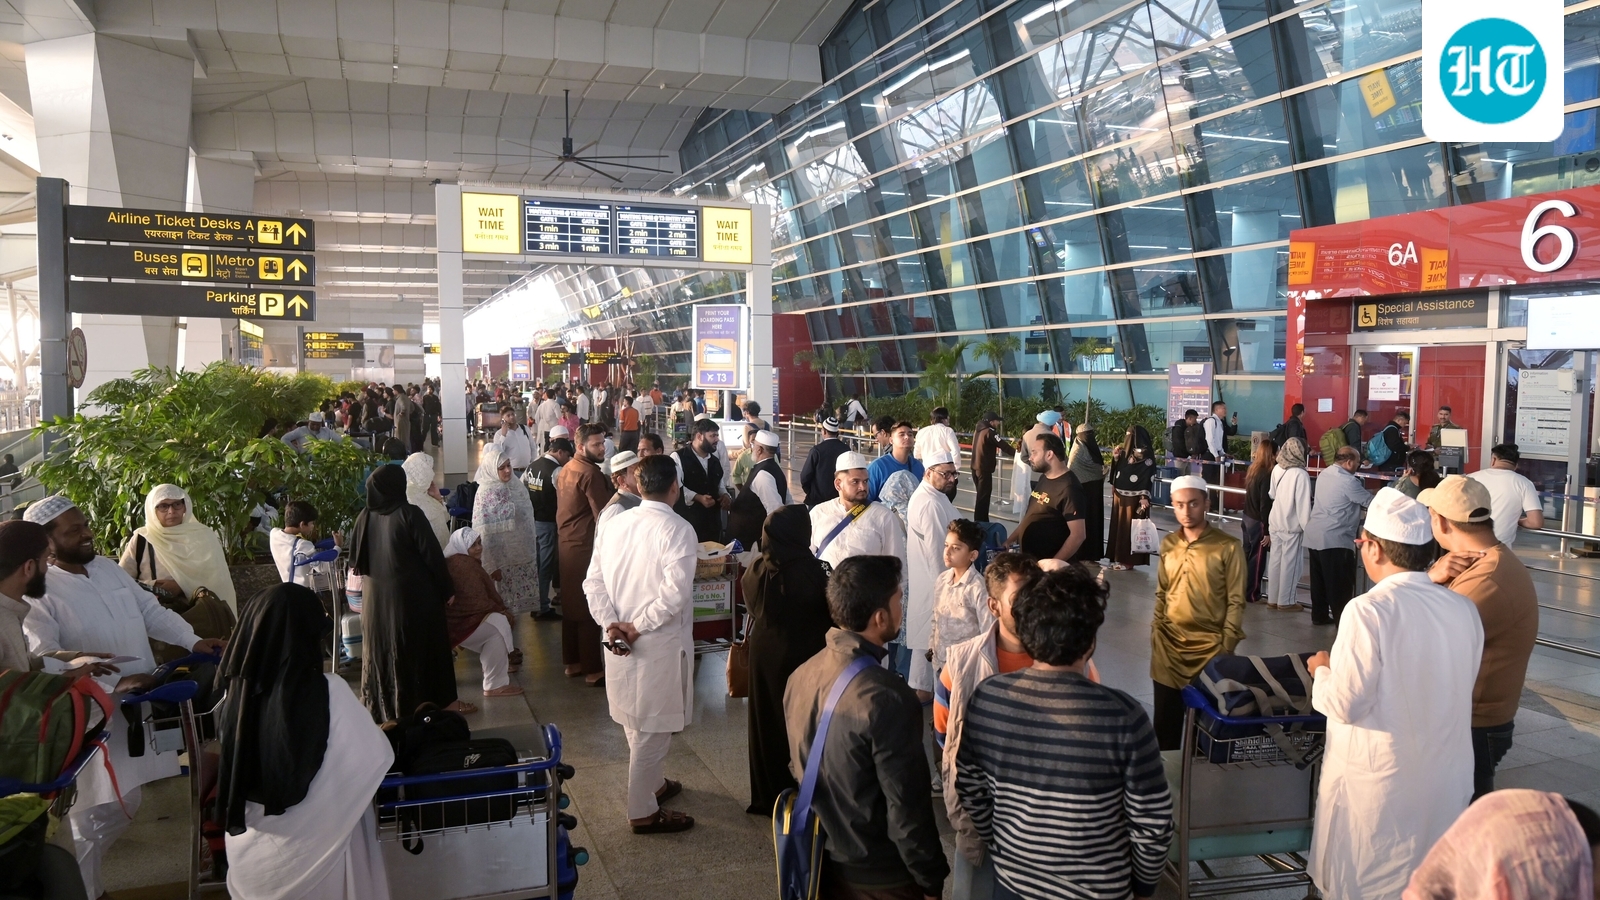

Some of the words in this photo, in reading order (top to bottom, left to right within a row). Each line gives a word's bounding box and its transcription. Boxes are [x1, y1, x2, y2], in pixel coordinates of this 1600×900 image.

[479, 207, 504, 217] WAIT
[108, 212, 150, 224] Airline
[155, 214, 196, 228] Ticket
[200, 216, 241, 230] Desks
[245, 220, 254, 230] A
[479, 220, 504, 230] TIME
[716, 220, 738, 230] WAIT
[144, 229, 183, 240] एयरलाइन
[187, 230, 210, 240] टिकट
[214, 231, 234, 241] डेस्क
[248, 235, 254, 244] ए
[716, 232, 738, 242] TIME
[1520, 200, 1577, 273] 6
[134, 250, 178, 264] Buses
[1388, 241, 1418, 266] 6A
[216, 254, 254, 267] Metro
[144, 267, 158, 275] बस
[162, 265, 178, 276] सेवा
[206, 290, 256, 305] Parking
[232, 305, 256, 315] पार्किंग
[266, 297, 278, 312] P
[1378, 303, 1414, 315] Special
[1416, 299, 1475, 311] Assistance
[1378, 318, 1393, 326] विशेष
[1396, 316, 1419, 325] सहायता
[717, 373, 726, 382] T3
[1305, 745, 1324, 761] Shahid
